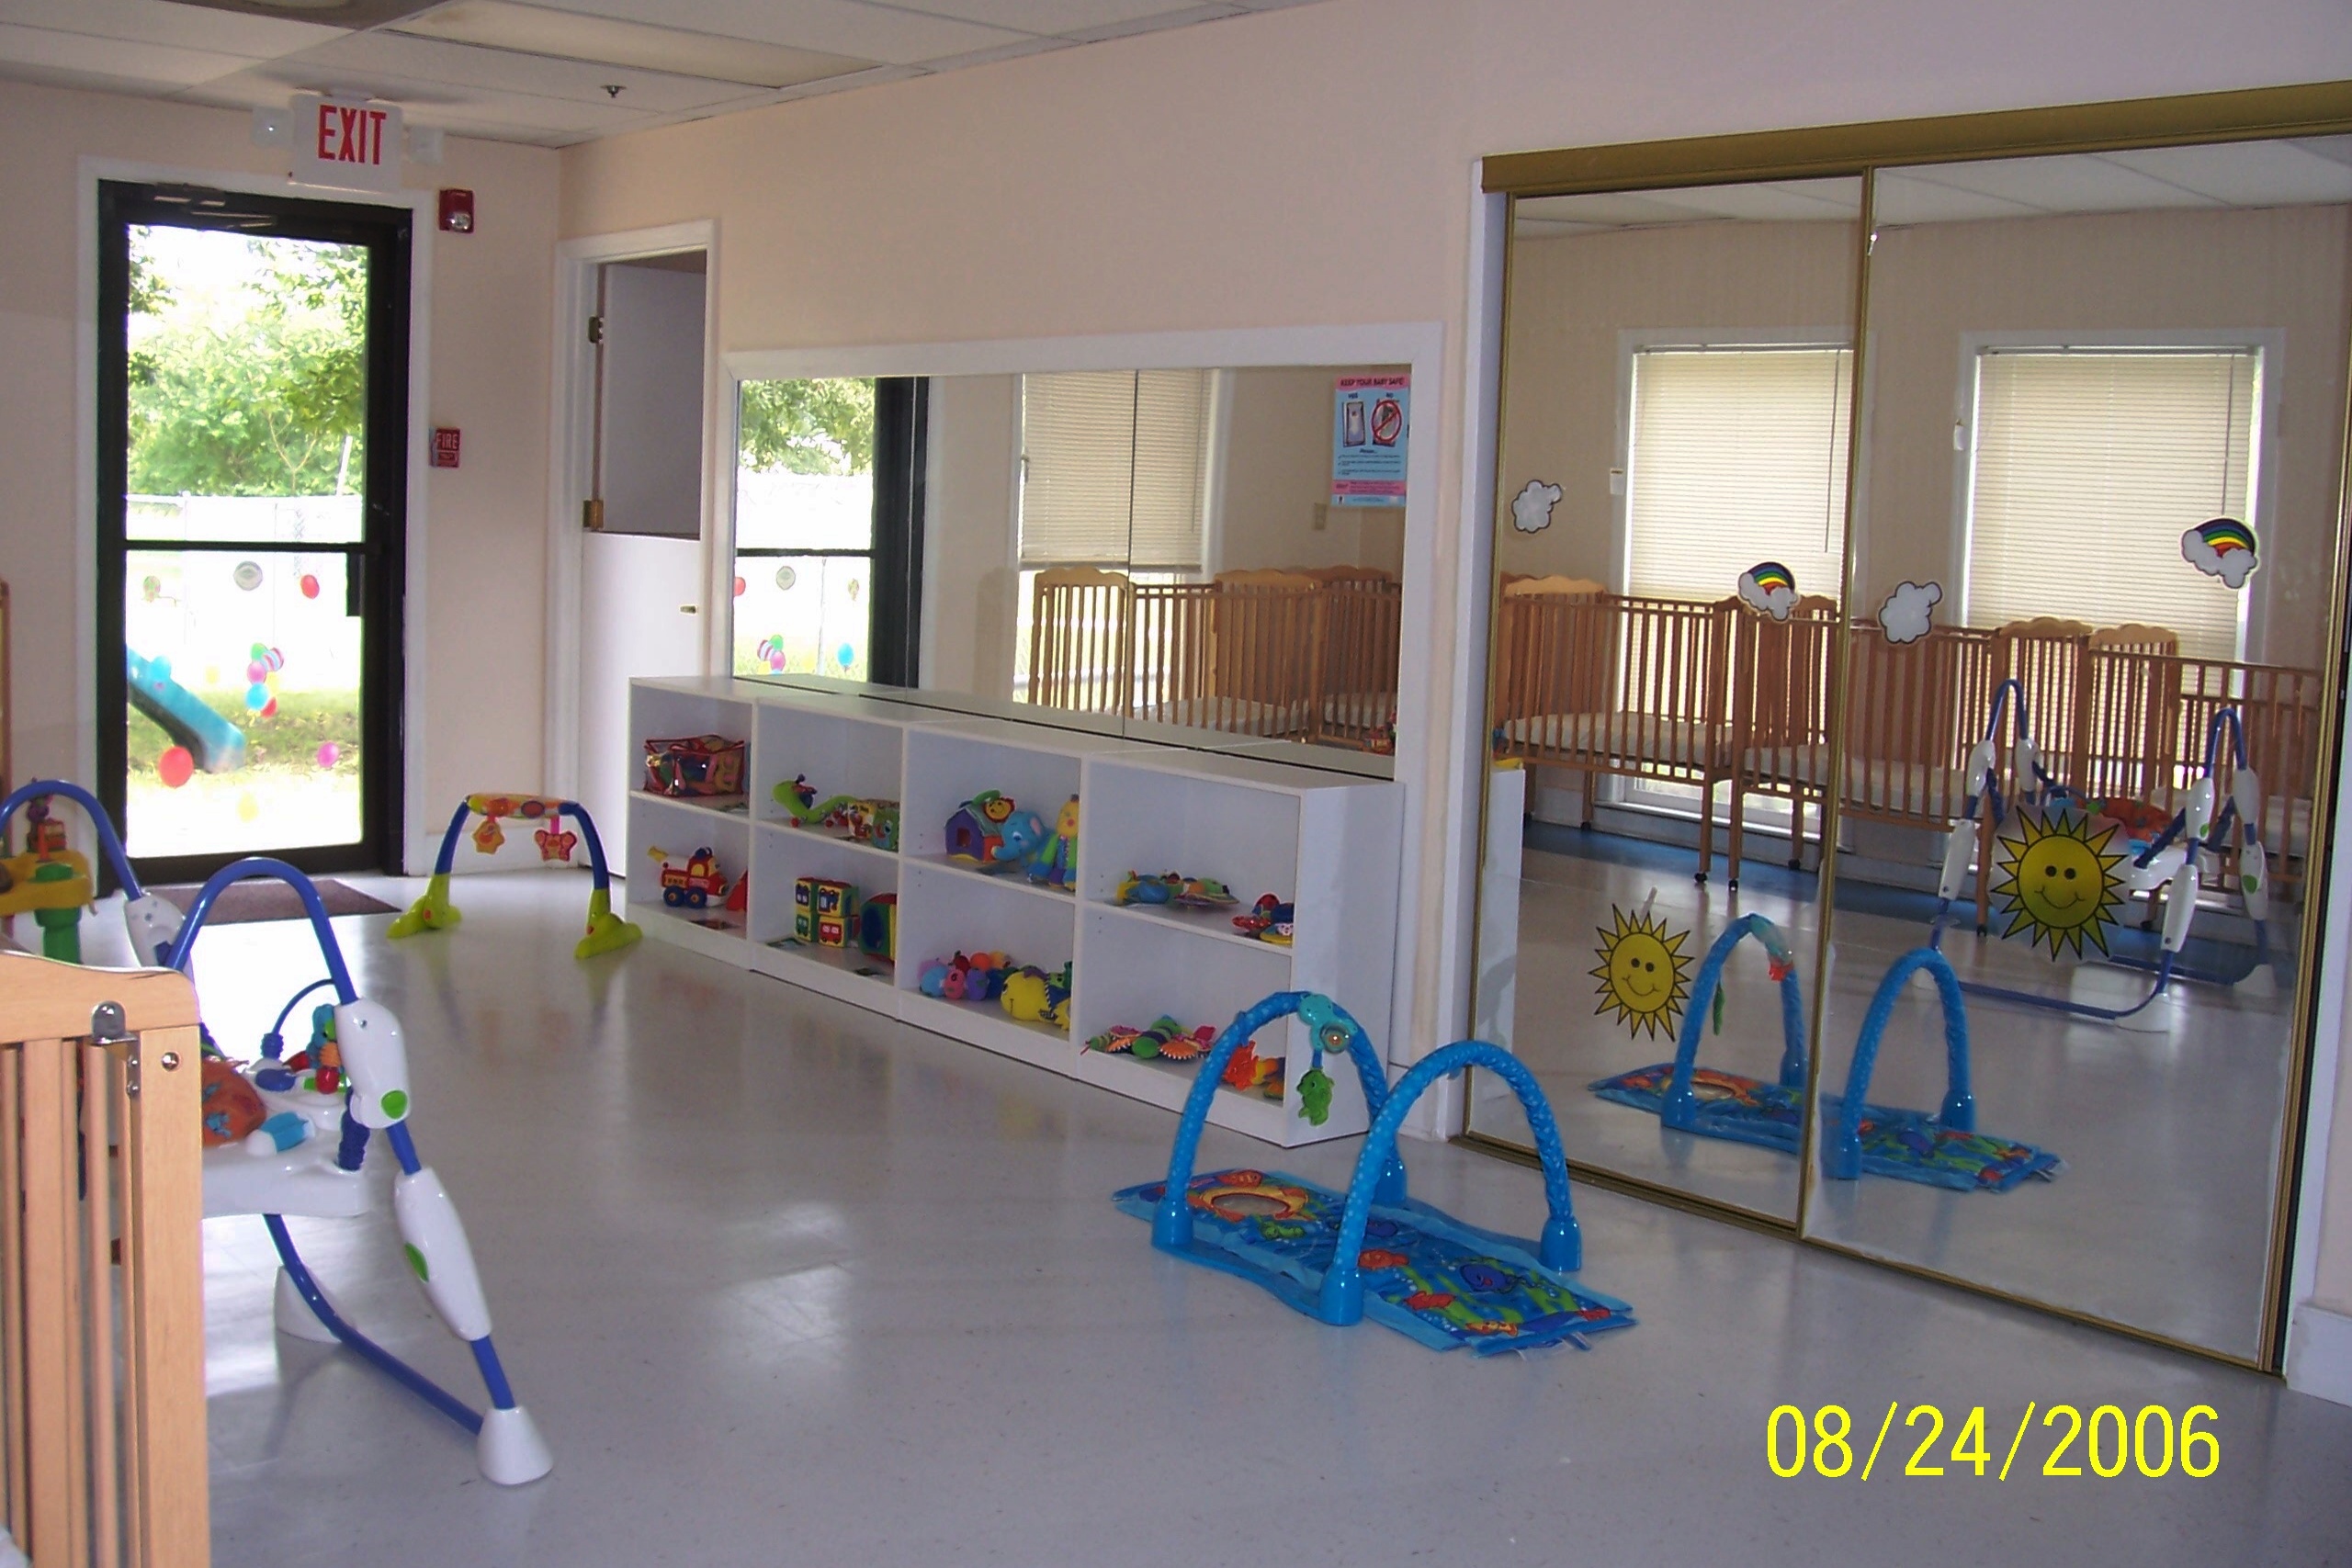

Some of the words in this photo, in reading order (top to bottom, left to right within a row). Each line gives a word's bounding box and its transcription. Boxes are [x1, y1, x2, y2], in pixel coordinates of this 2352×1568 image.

[318, 105, 387, 165] EXIT
[1340, 378, 1355, 387] KEEP
[1356, 378, 1372, 386] YOUR
[1374, 378, 1388, 386] BABY
[436, 433, 458, 449] FIRE
